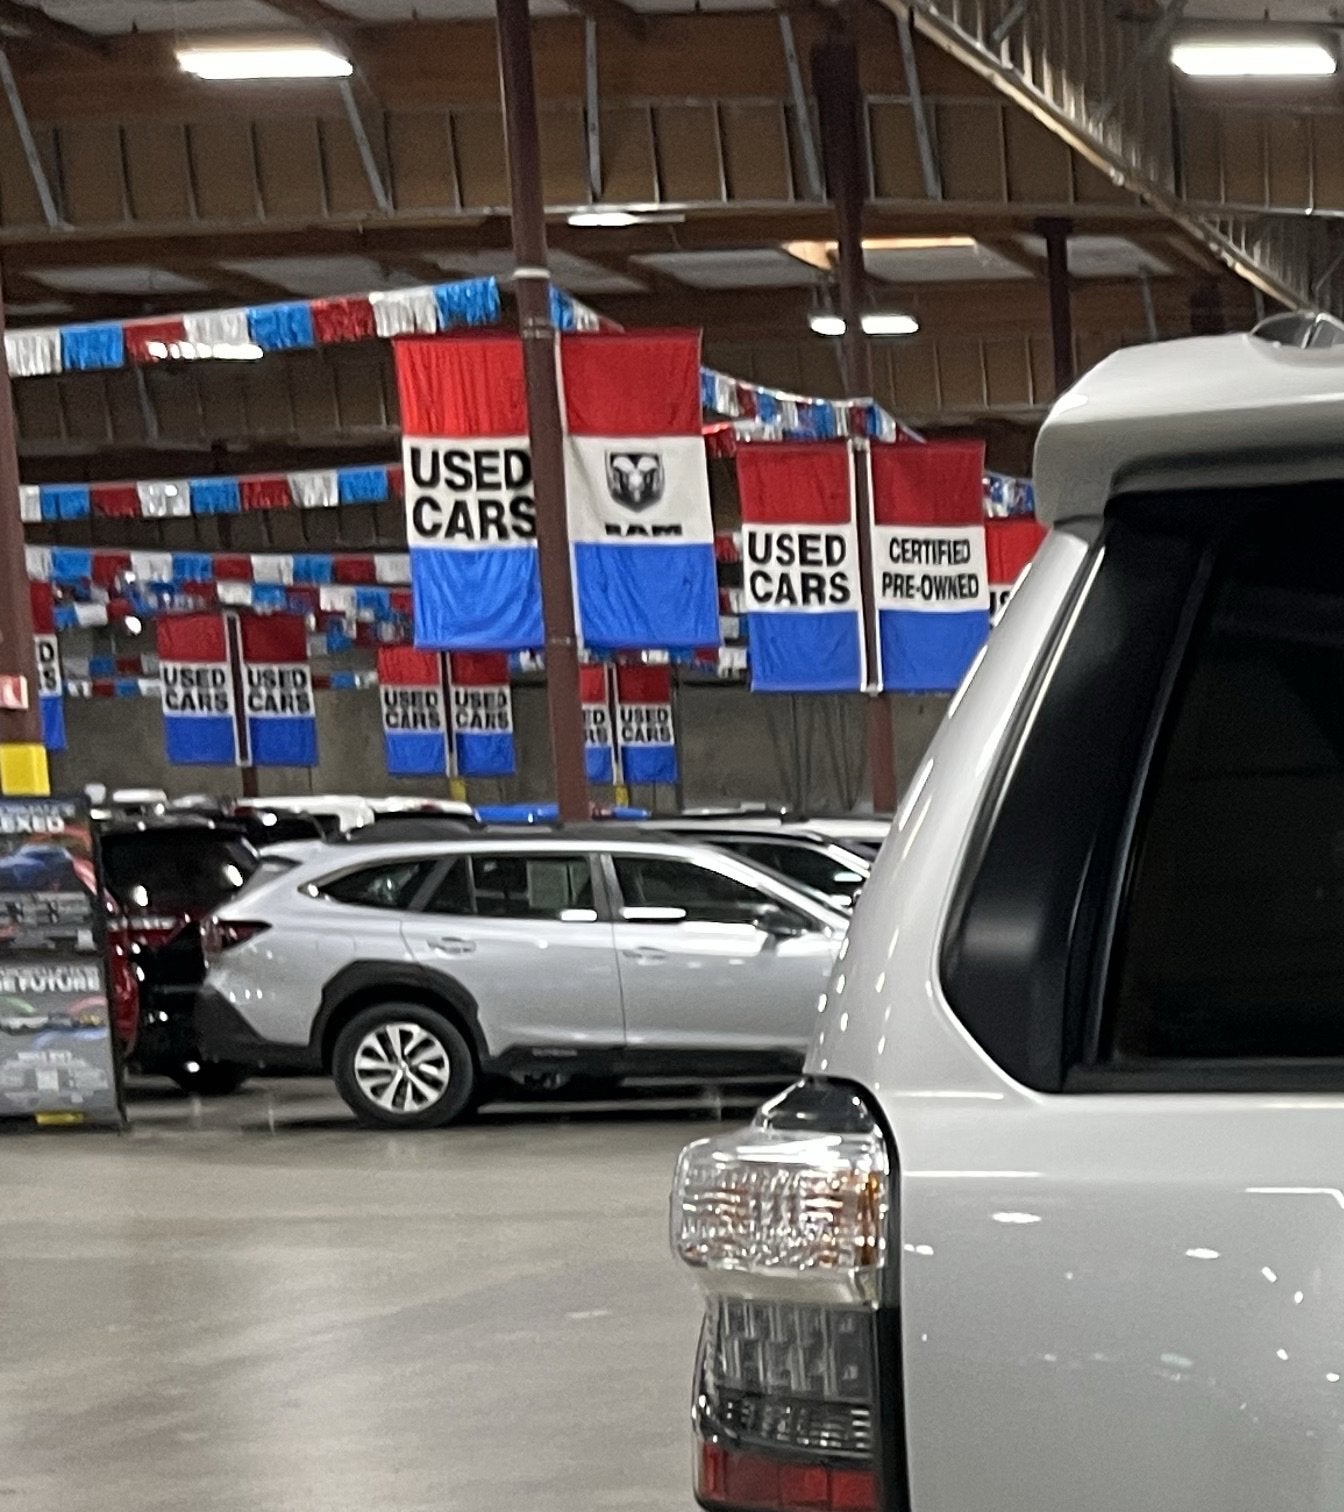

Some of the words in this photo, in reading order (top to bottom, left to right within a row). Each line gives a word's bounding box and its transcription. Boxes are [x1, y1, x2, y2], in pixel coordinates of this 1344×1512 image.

[410, 448, 531, 492] USED
[412, 496, 536, 540] CARS
[748, 531, 847, 567] USED
[889, 536, 971, 565] CERTIFIED
[750, 570, 851, 605] CARS
[882, 571, 980, 600] PRE-OWNED
[162, 665, 226, 688] USED
[248, 666, 309, 689] USED
